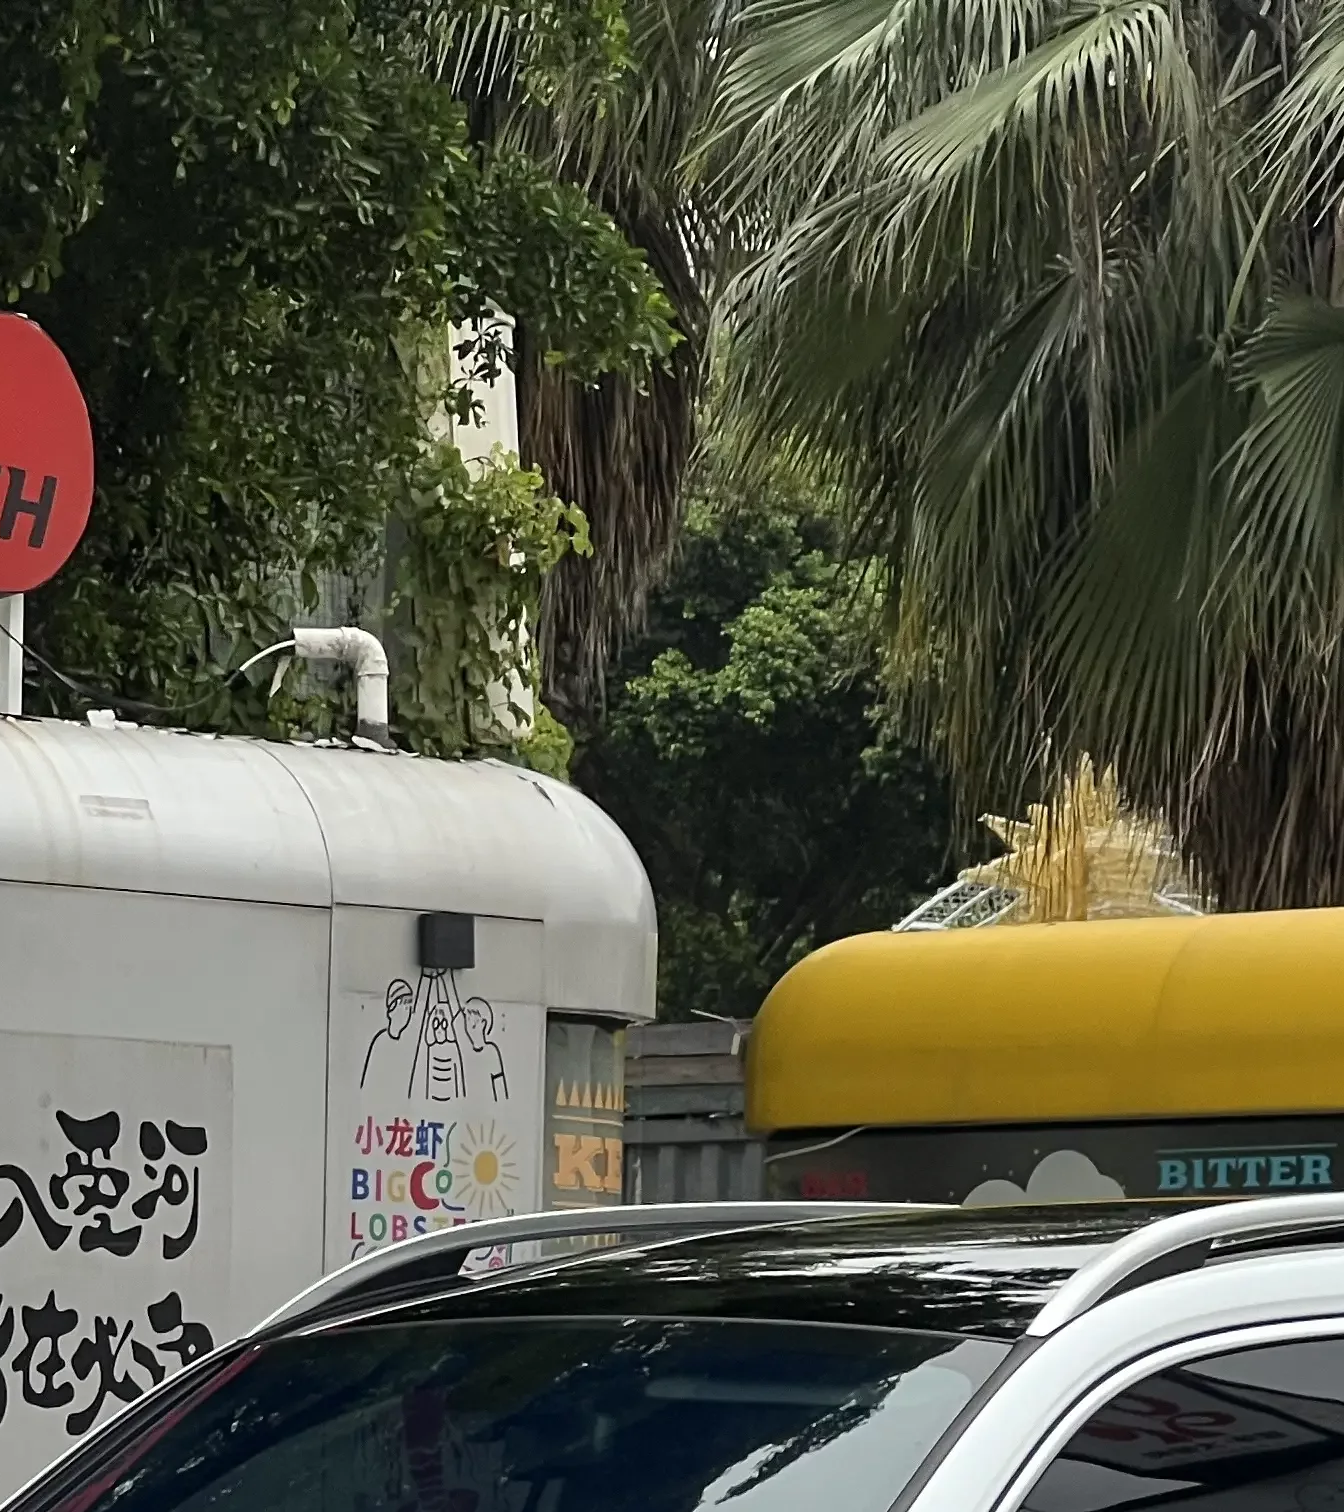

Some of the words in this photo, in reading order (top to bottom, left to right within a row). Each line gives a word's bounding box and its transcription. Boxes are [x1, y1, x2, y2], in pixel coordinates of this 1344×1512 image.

[355, 1116, 445, 1159] 小龙虾
[1158, 1154, 1332, 1191] BITTER
